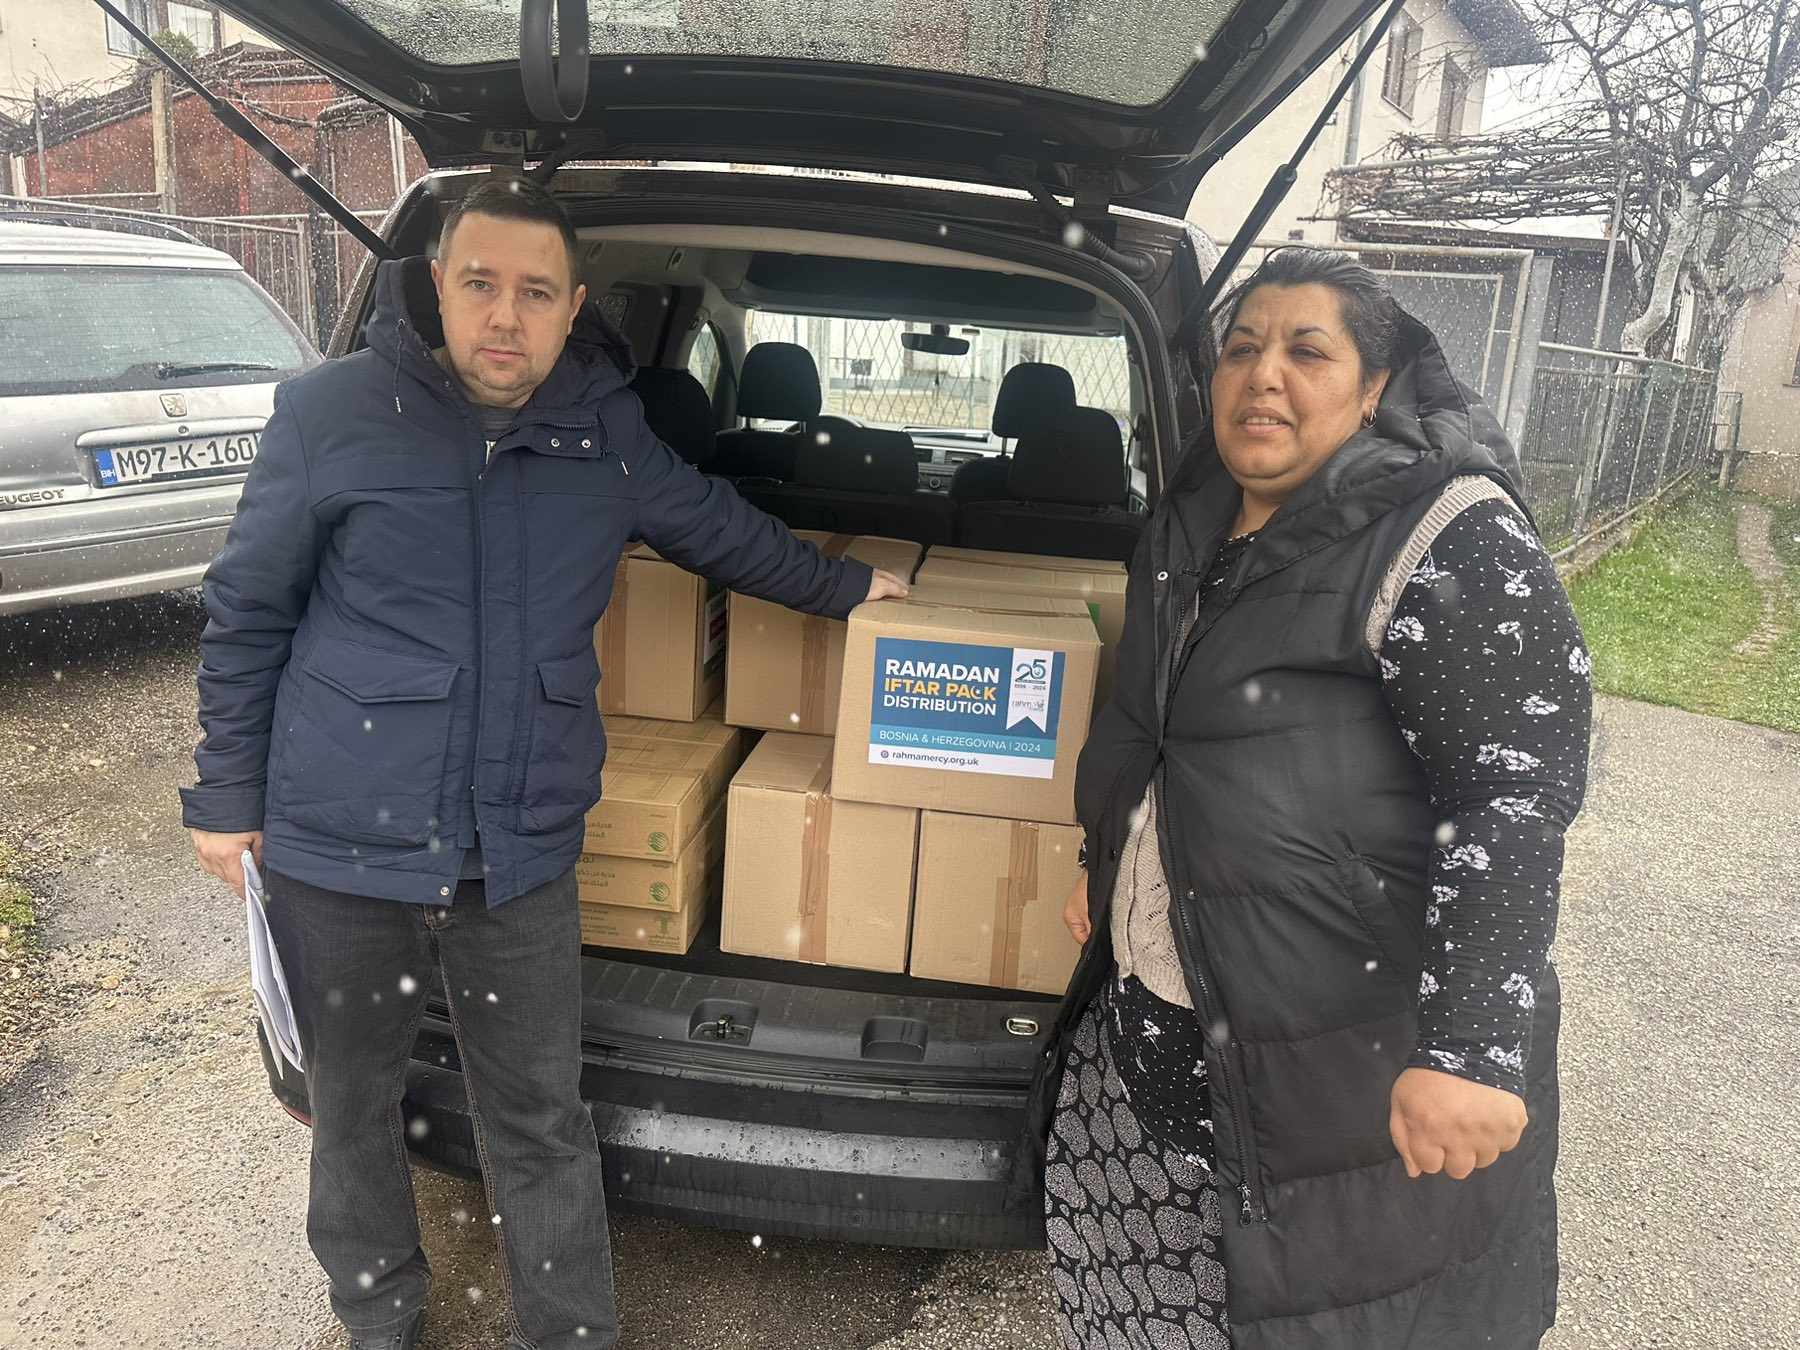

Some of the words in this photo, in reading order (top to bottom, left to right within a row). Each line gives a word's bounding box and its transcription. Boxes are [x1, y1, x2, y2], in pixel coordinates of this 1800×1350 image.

[117, 437, 253, 478] M97-K-160
[101, 469, 117, 479] BIH
[885, 659, 1000, 684] RAMADAN
[1015, 659, 1047, 684] 25
[884, 678, 940, 696] IFTAR
[946, 682, 997, 701] PACK
[883, 695, 997, 715] DISTRIBUTION
[879, 730, 919, 744] BOSNIA
[921, 734, 929, 744] &
[931, 735, 1006, 751] HERZEGOVINA
[1014, 742, 1041, 753] 2024
[892, 751, 979, 766] rahmamercy.org.uk
